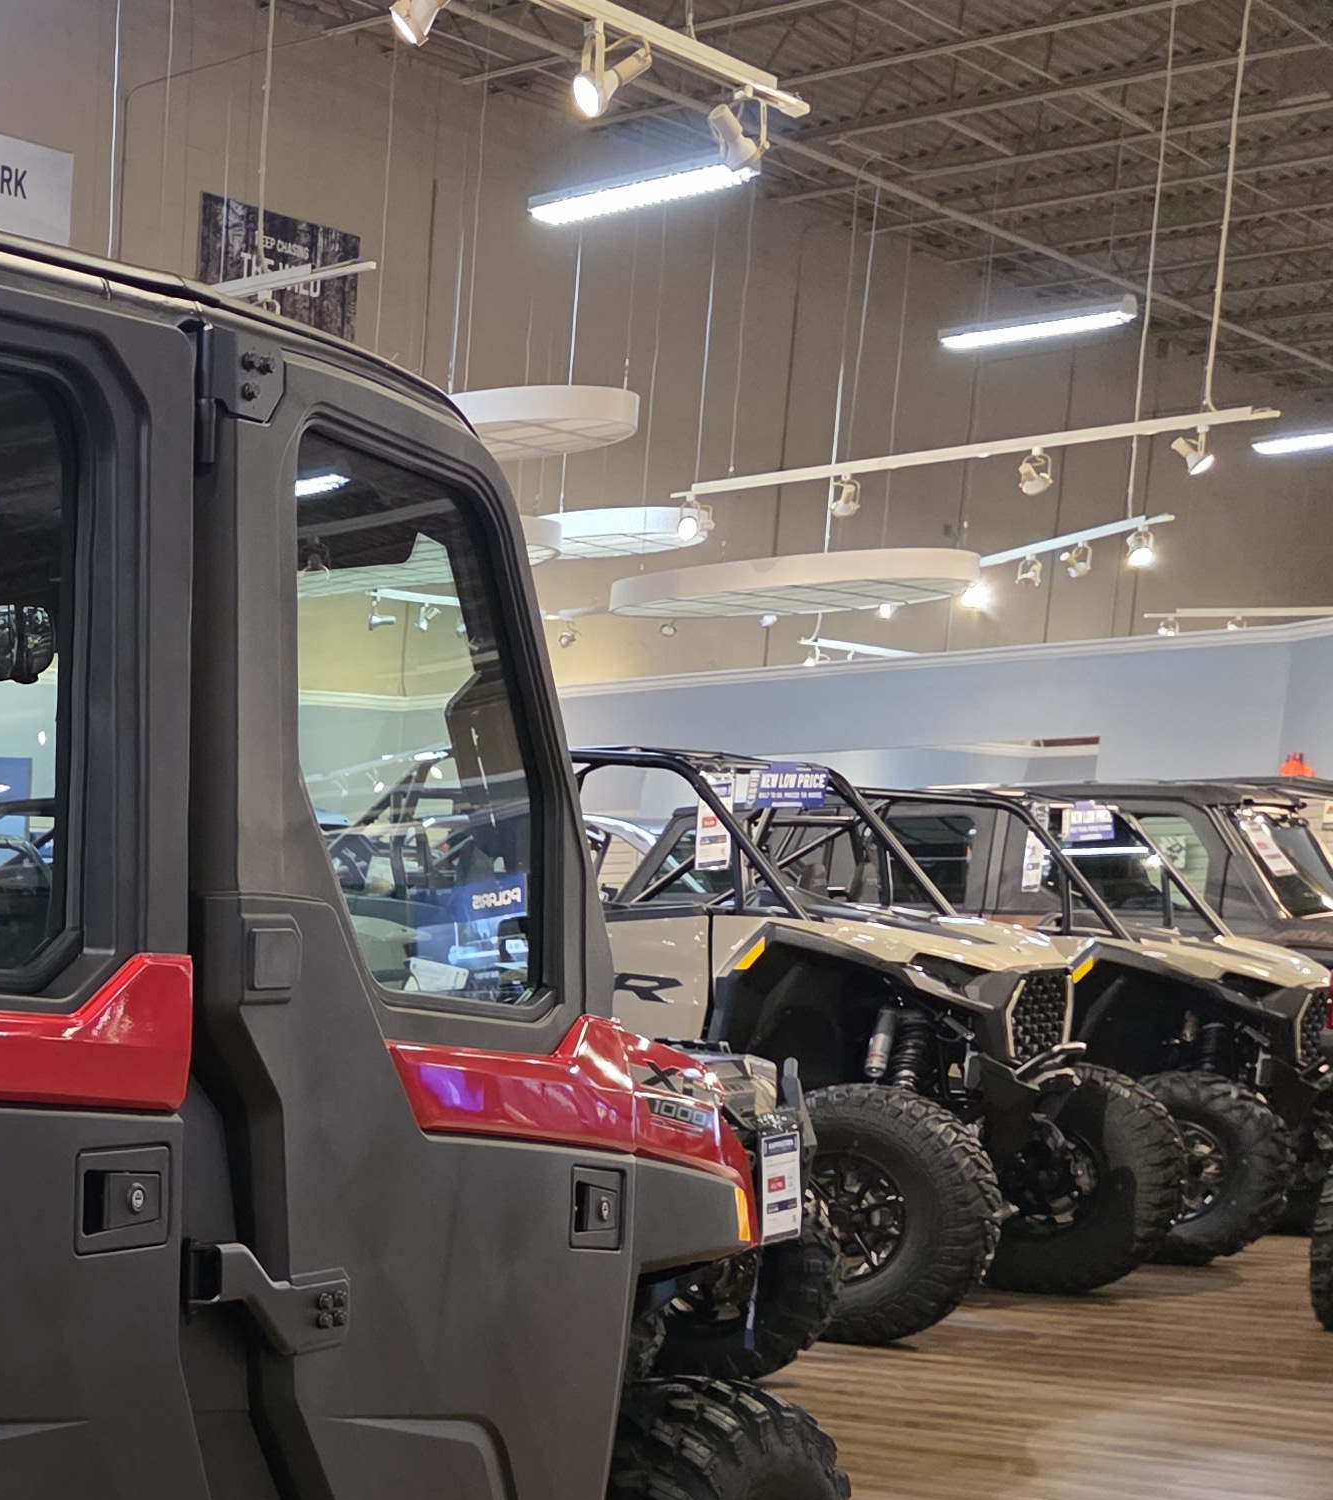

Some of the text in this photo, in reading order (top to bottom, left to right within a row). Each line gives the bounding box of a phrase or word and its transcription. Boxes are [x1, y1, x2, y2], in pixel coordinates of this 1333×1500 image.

[276, 239, 310, 259] CHASING
[797, 773, 827, 789] PRICE
[652, 1099, 710, 1127] 1000
